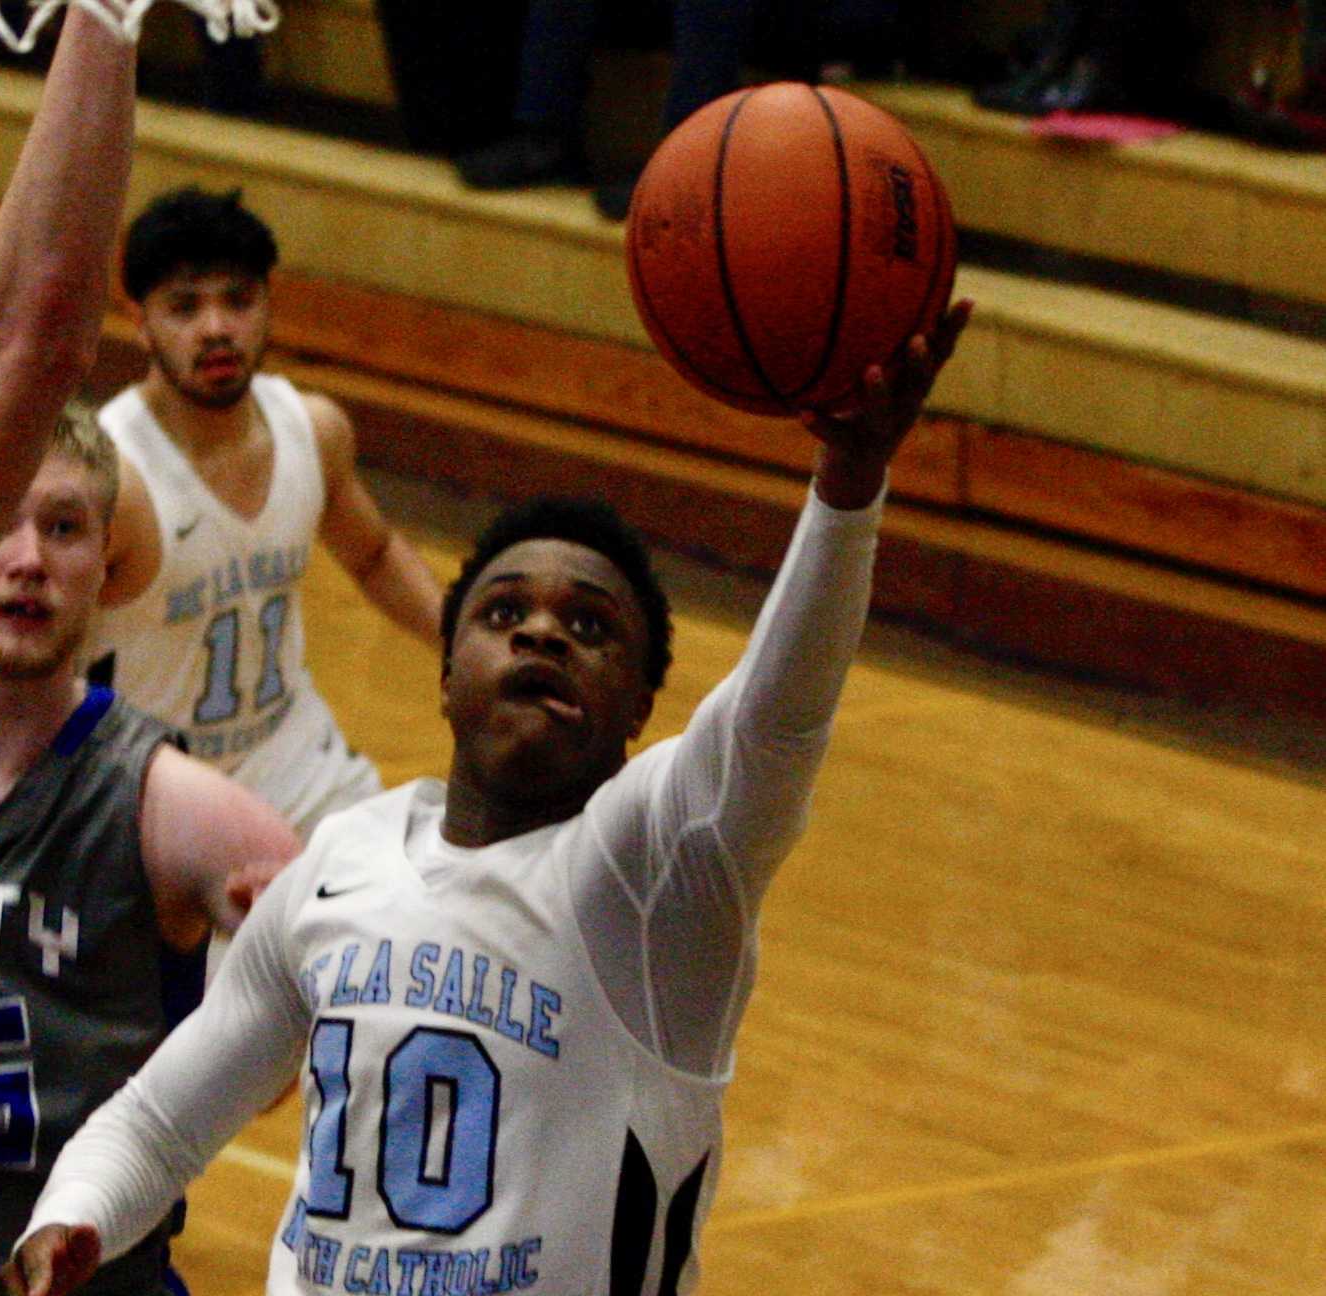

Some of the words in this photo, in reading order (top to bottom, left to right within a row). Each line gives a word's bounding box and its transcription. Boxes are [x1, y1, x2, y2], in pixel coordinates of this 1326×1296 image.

[193, 596, 287, 725] 11
[330, 940, 393, 1007] LA
[405, 940, 562, 1059] SALLE
[307, 1018, 502, 1236] 10
